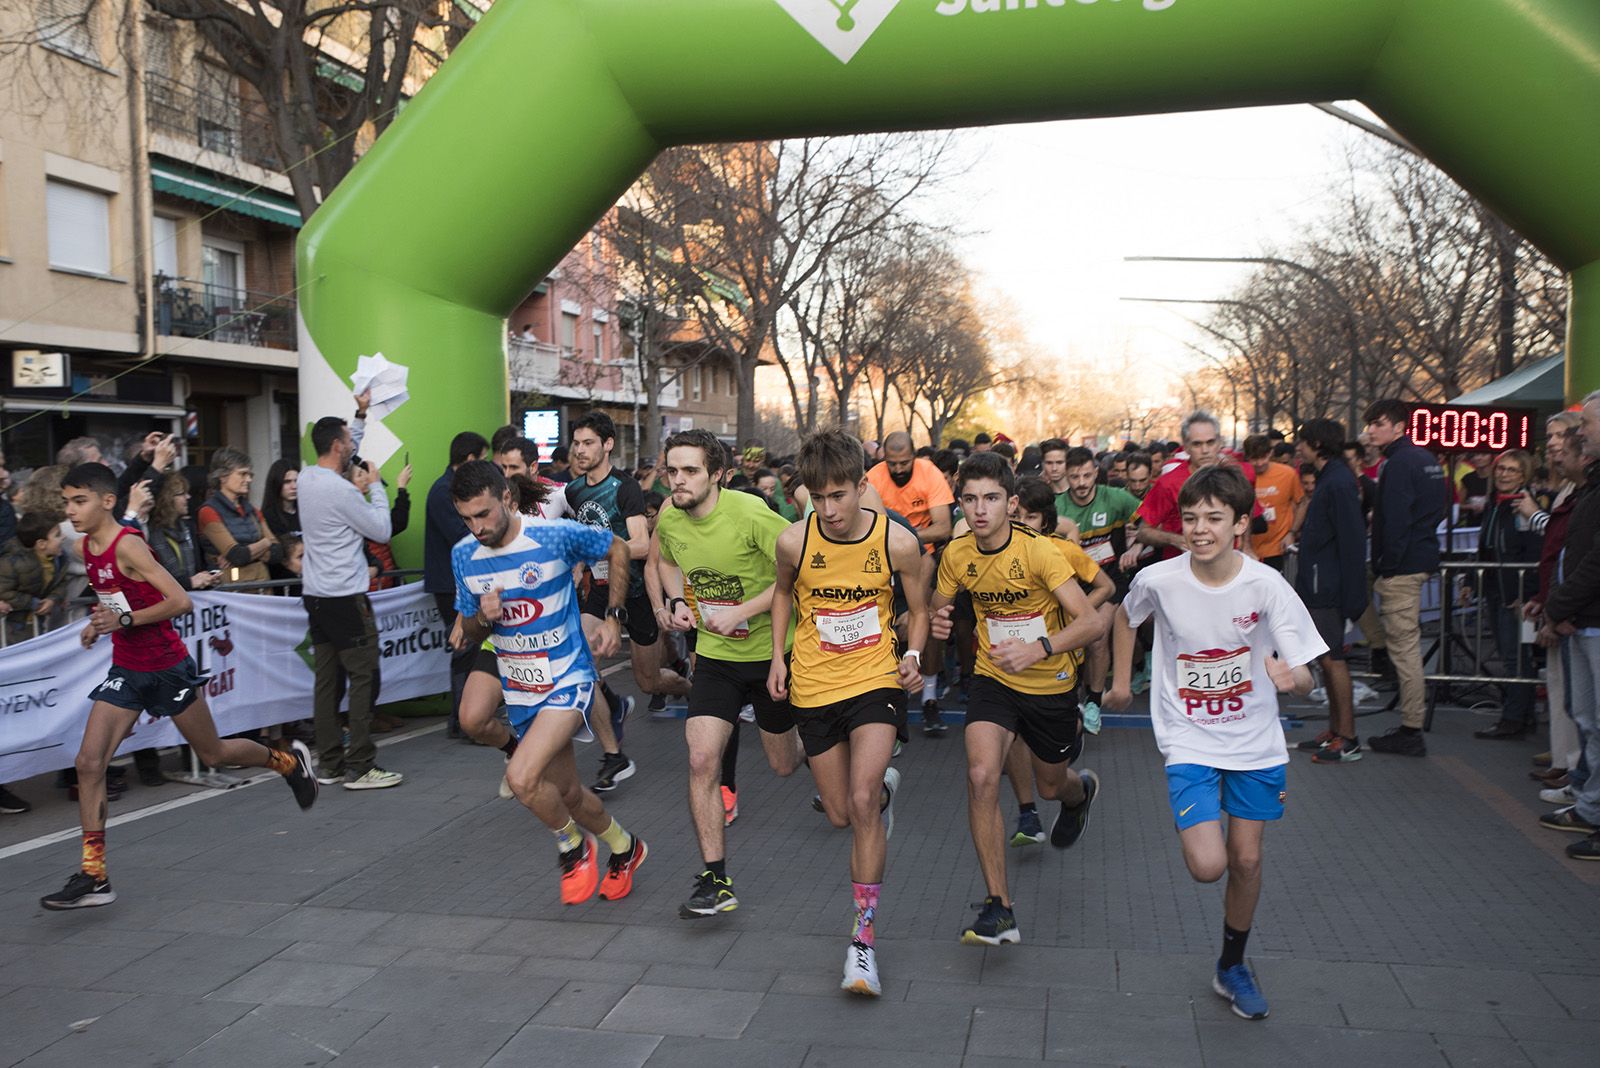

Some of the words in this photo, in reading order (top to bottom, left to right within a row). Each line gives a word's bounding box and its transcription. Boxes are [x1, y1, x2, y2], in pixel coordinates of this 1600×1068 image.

[1406, 408, 1528, 449] 0:00:01
[172, 611, 195, 638] SA
[377, 607, 440, 633] JUNTAME
[502, 603, 530, 621] ANI
[834, 621, 864, 633] PABLO
[841, 631, 860, 643] 139
[196, 639, 212, 676] L
[202, 667, 236, 697] GAT
[508, 665, 545, 683] 2003
[1187, 666, 1243, 689] 2146
[0, 688, 59, 714] YENC
